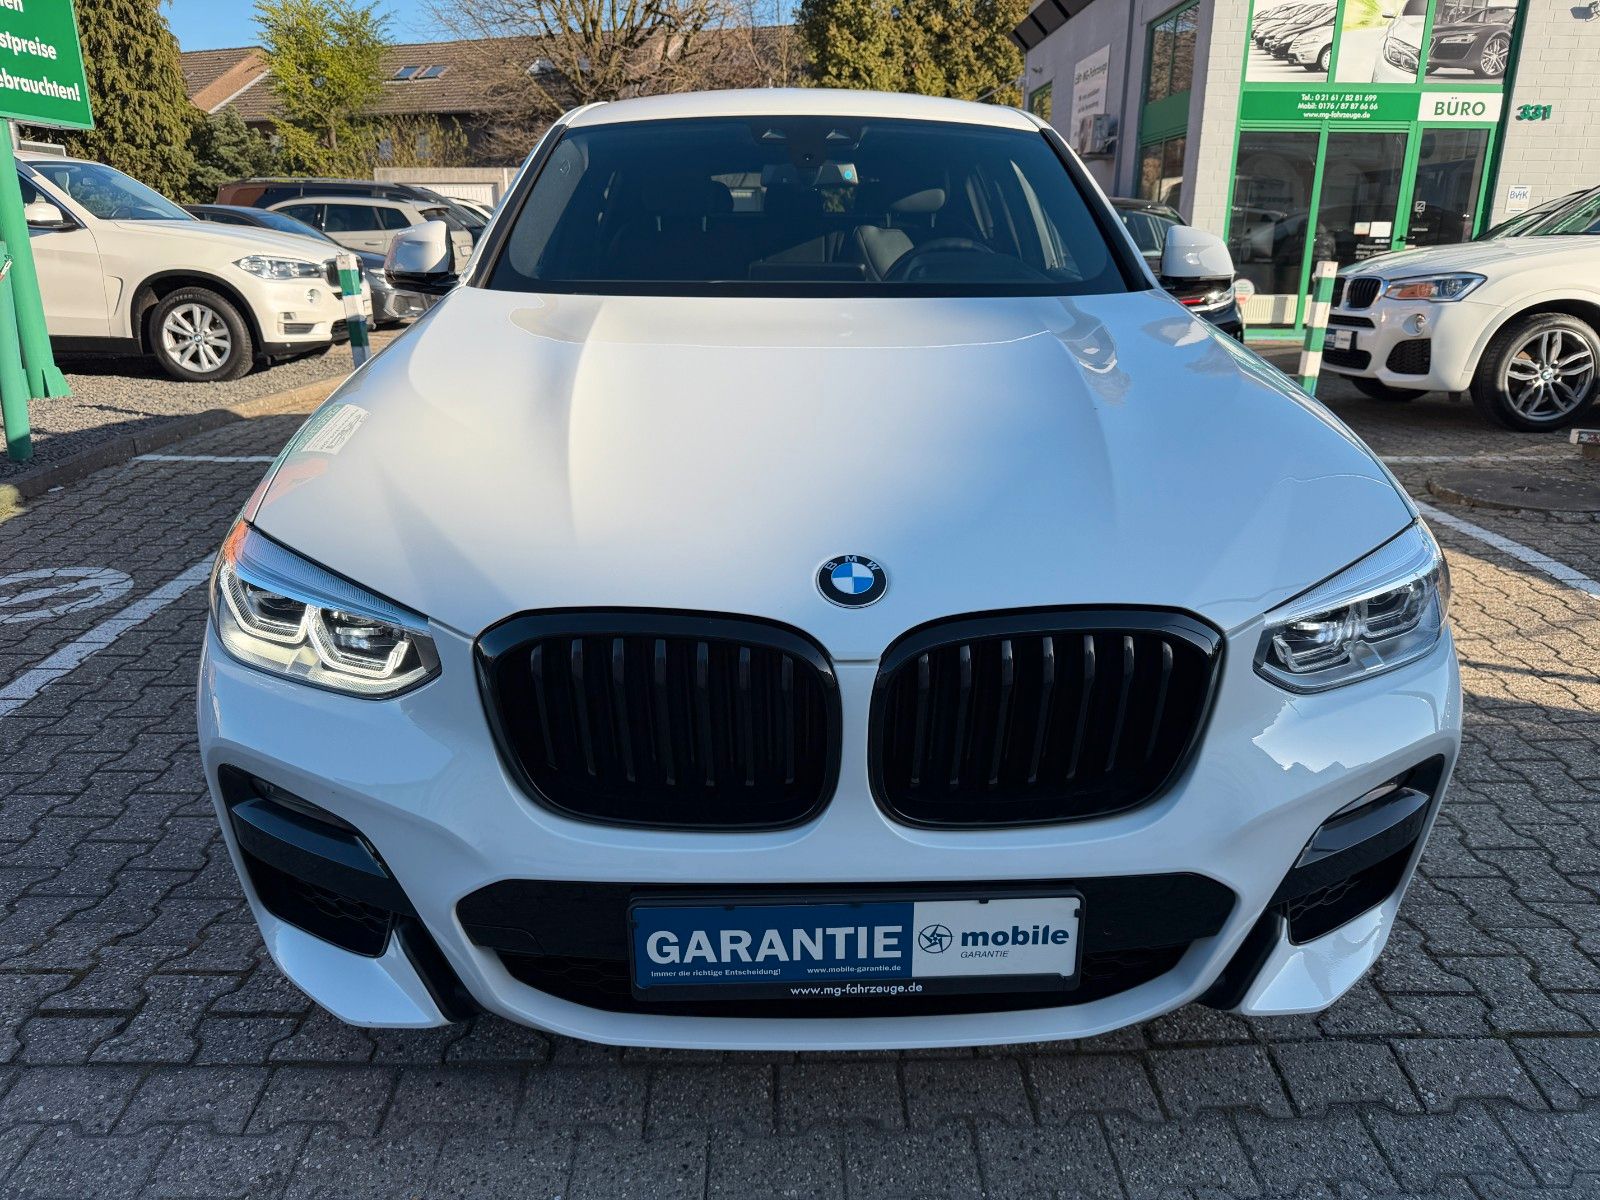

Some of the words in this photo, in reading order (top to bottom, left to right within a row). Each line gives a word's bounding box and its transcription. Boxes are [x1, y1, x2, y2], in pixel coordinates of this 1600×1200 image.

[1301, 93, 1314, 101] Tel.:
[1315, 93, 1321, 101] 0
[1354, 94, 1363, 102] 81
[1297, 102, 1317, 110] Mobil:
[1318, 102, 1335, 110] 0176
[1433, 96, 1486, 116] BÜRO
[1303, 111, 1371, 120] www.mg-fahrzeuge.de
[825, 555, 881, 571] BMW
[961, 925, 1070, 947] mobile
[646, 926, 903, 964] GARANTIE
[960, 949, 1010, 959] GARANTIE
[692, 969, 723, 977] richtige
[724, 968, 781, 977] Entscheidung!
[806, 964, 902, 974] www.mobile-garantie.de
[790, 981, 923, 997] www.mg-fahrzeuge.de
